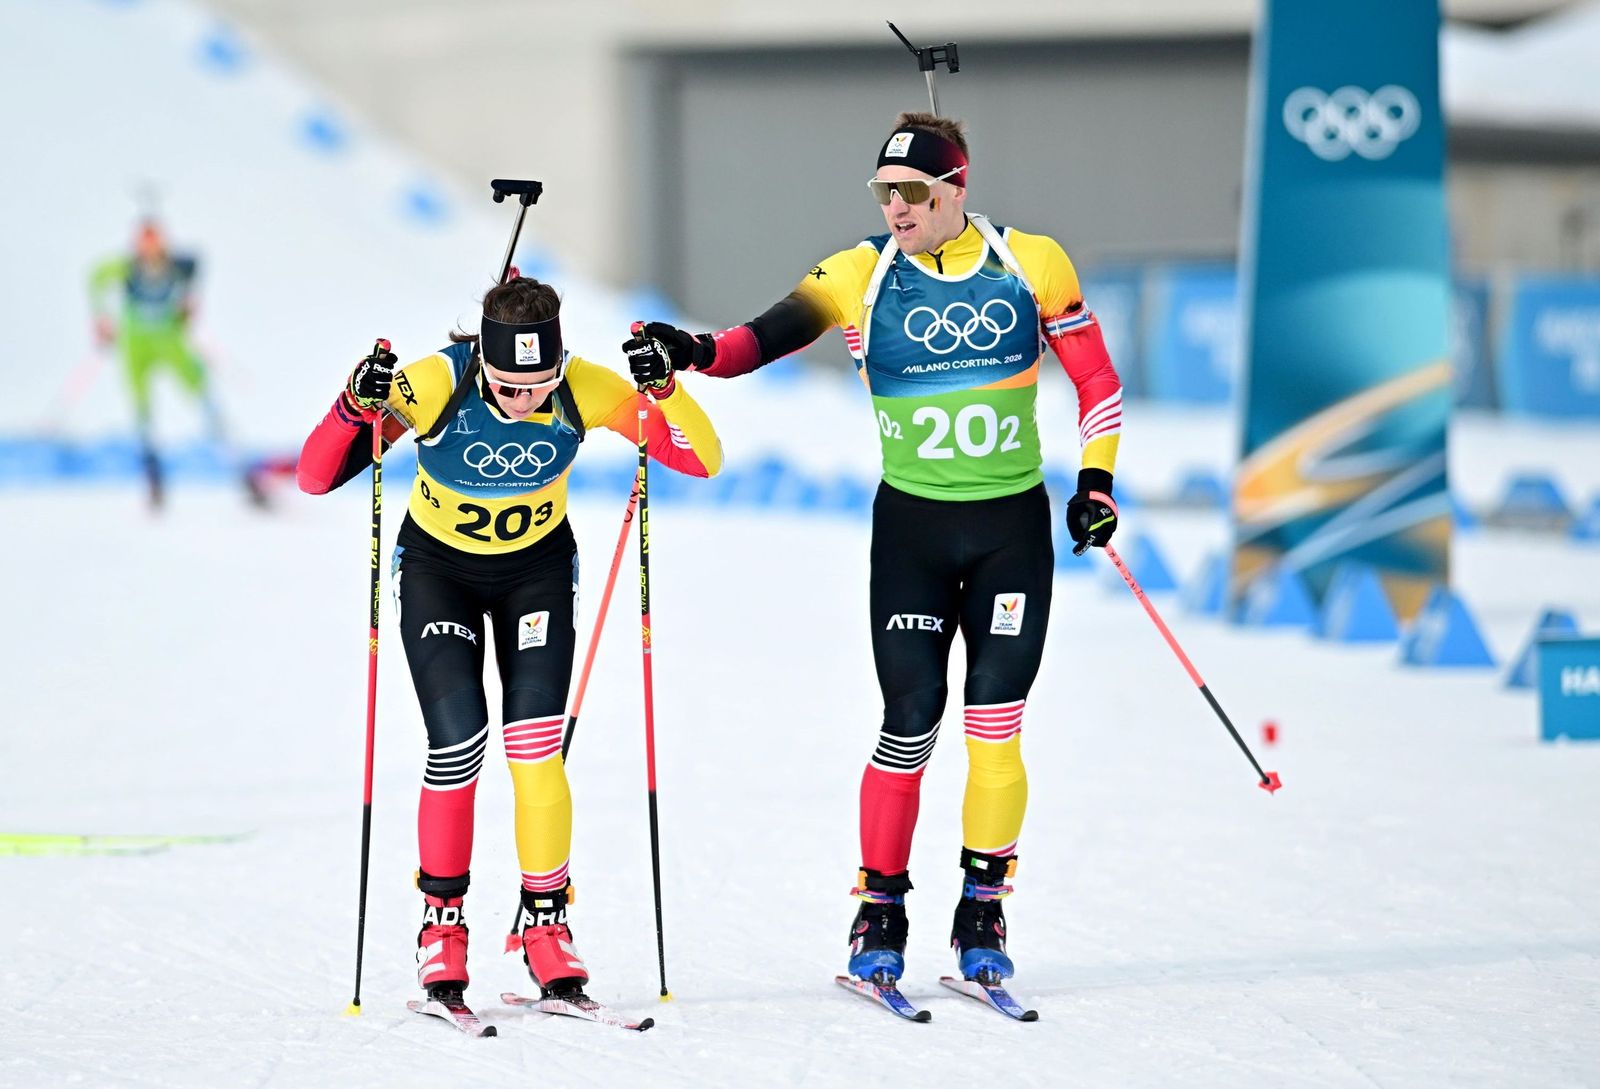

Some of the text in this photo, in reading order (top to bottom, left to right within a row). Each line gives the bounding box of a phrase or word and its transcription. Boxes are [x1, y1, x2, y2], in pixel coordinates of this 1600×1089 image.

[902, 353, 1022, 374] MILANO CORTINA 2026
[912, 403, 1021, 460] 202
[454, 479, 496, 487] MILANO
[454, 500, 554, 543] 203
[641, 506, 649, 555] LEKI
[420, 621, 477, 646] ATEX
[885, 613, 944, 633] ATEX
